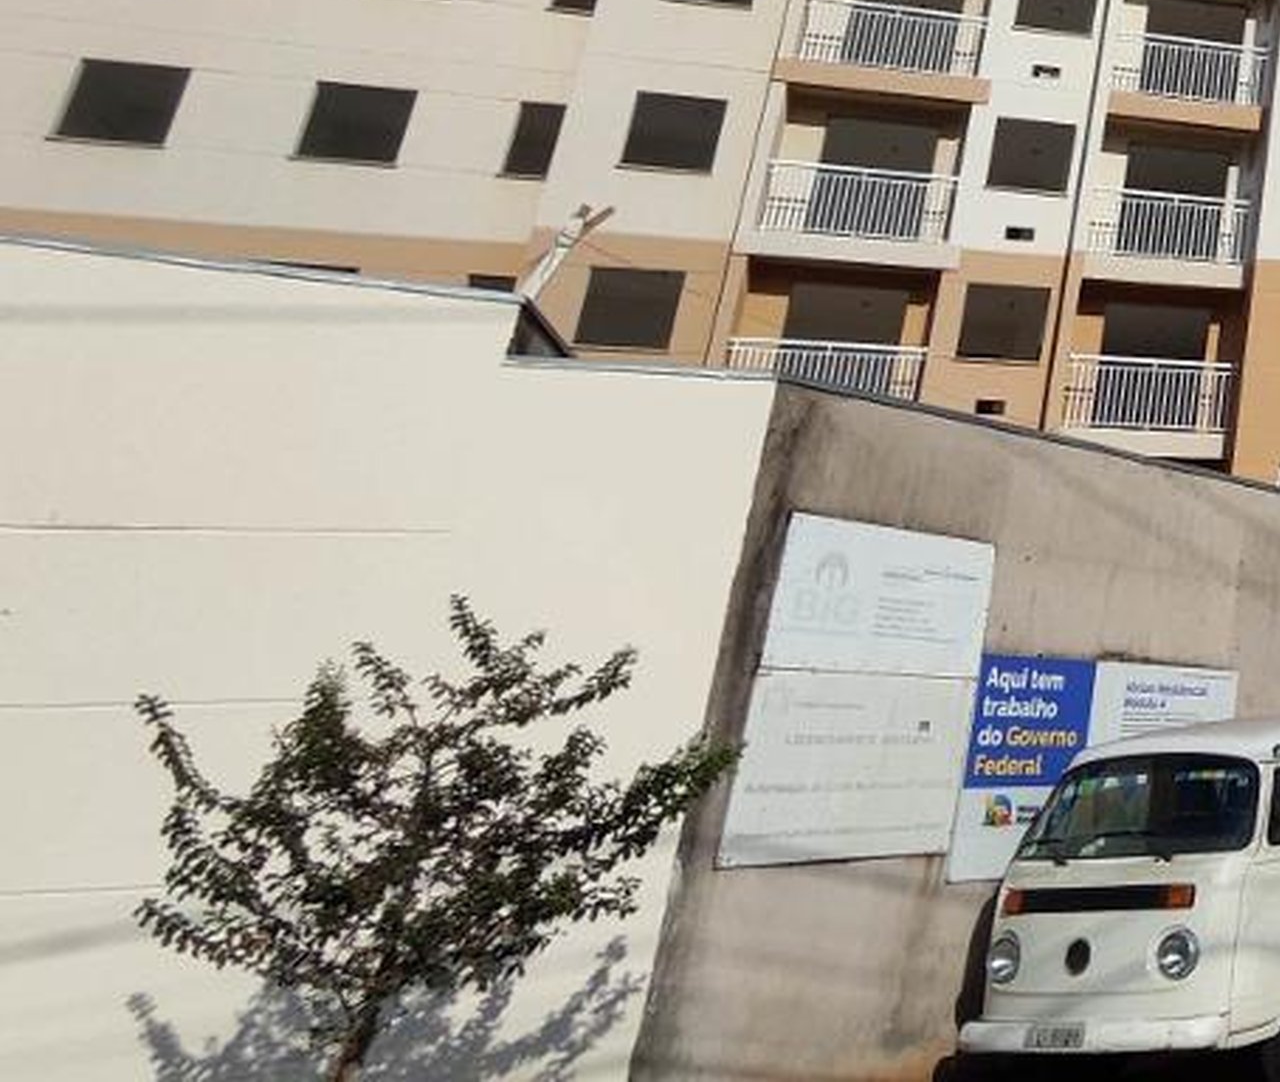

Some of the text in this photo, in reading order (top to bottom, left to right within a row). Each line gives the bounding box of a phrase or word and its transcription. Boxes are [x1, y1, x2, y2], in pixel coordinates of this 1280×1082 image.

[986, 667, 1065, 692] Aqui tem
[982, 695, 1059, 719] trabalho
[977, 726, 1078, 747] do Governo
[974, 754, 1041, 776] Federal
